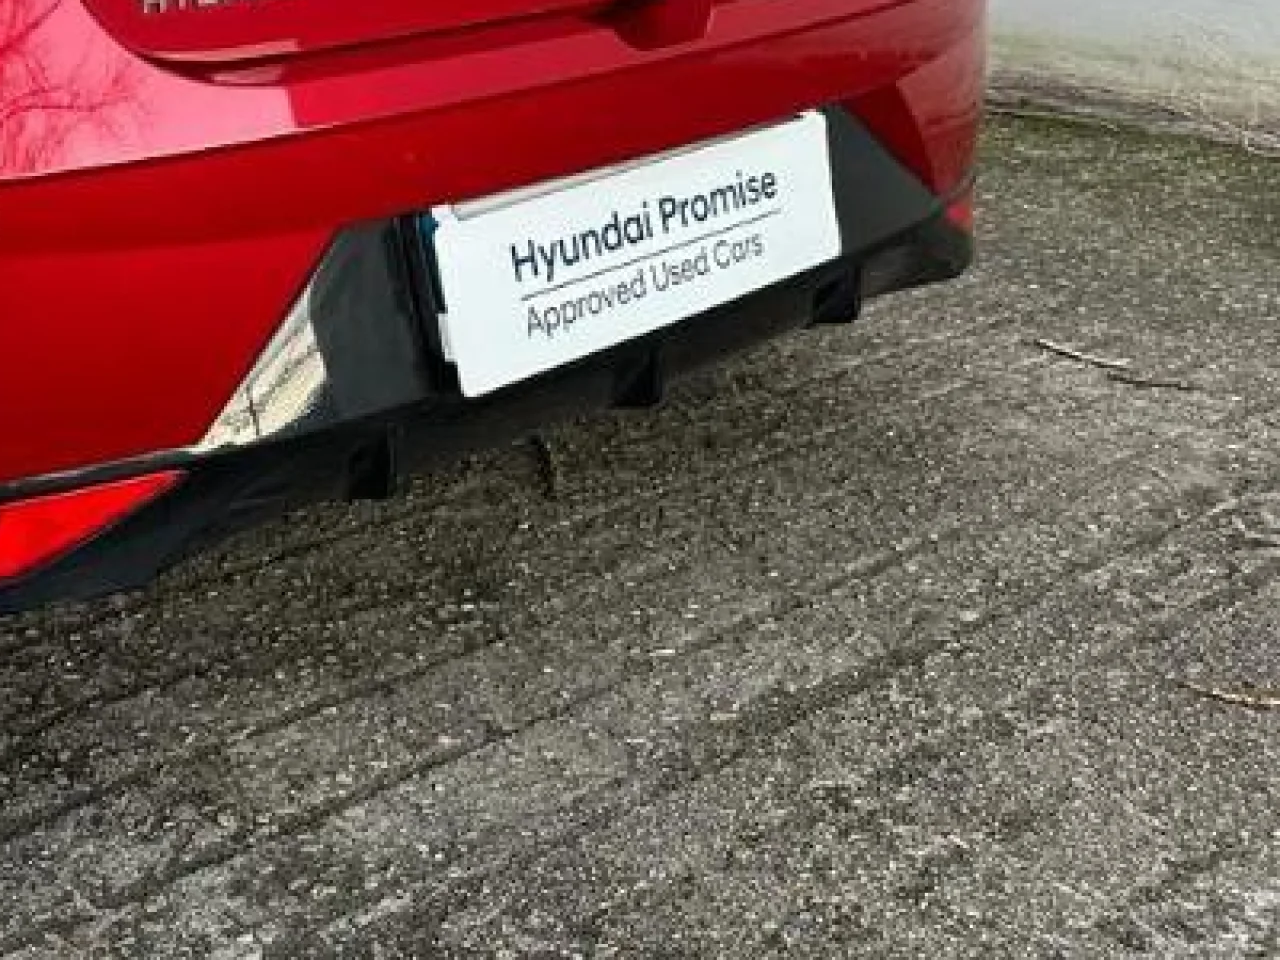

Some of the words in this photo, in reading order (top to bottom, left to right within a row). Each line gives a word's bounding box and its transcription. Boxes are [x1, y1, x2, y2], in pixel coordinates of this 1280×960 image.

[510, 201, 653, 282] Hyundai
[658, 170, 777, 234] Promise
[526, 272, 648, 338] Approved
[649, 249, 710, 293] Used
[712, 233, 764, 271] Cars
